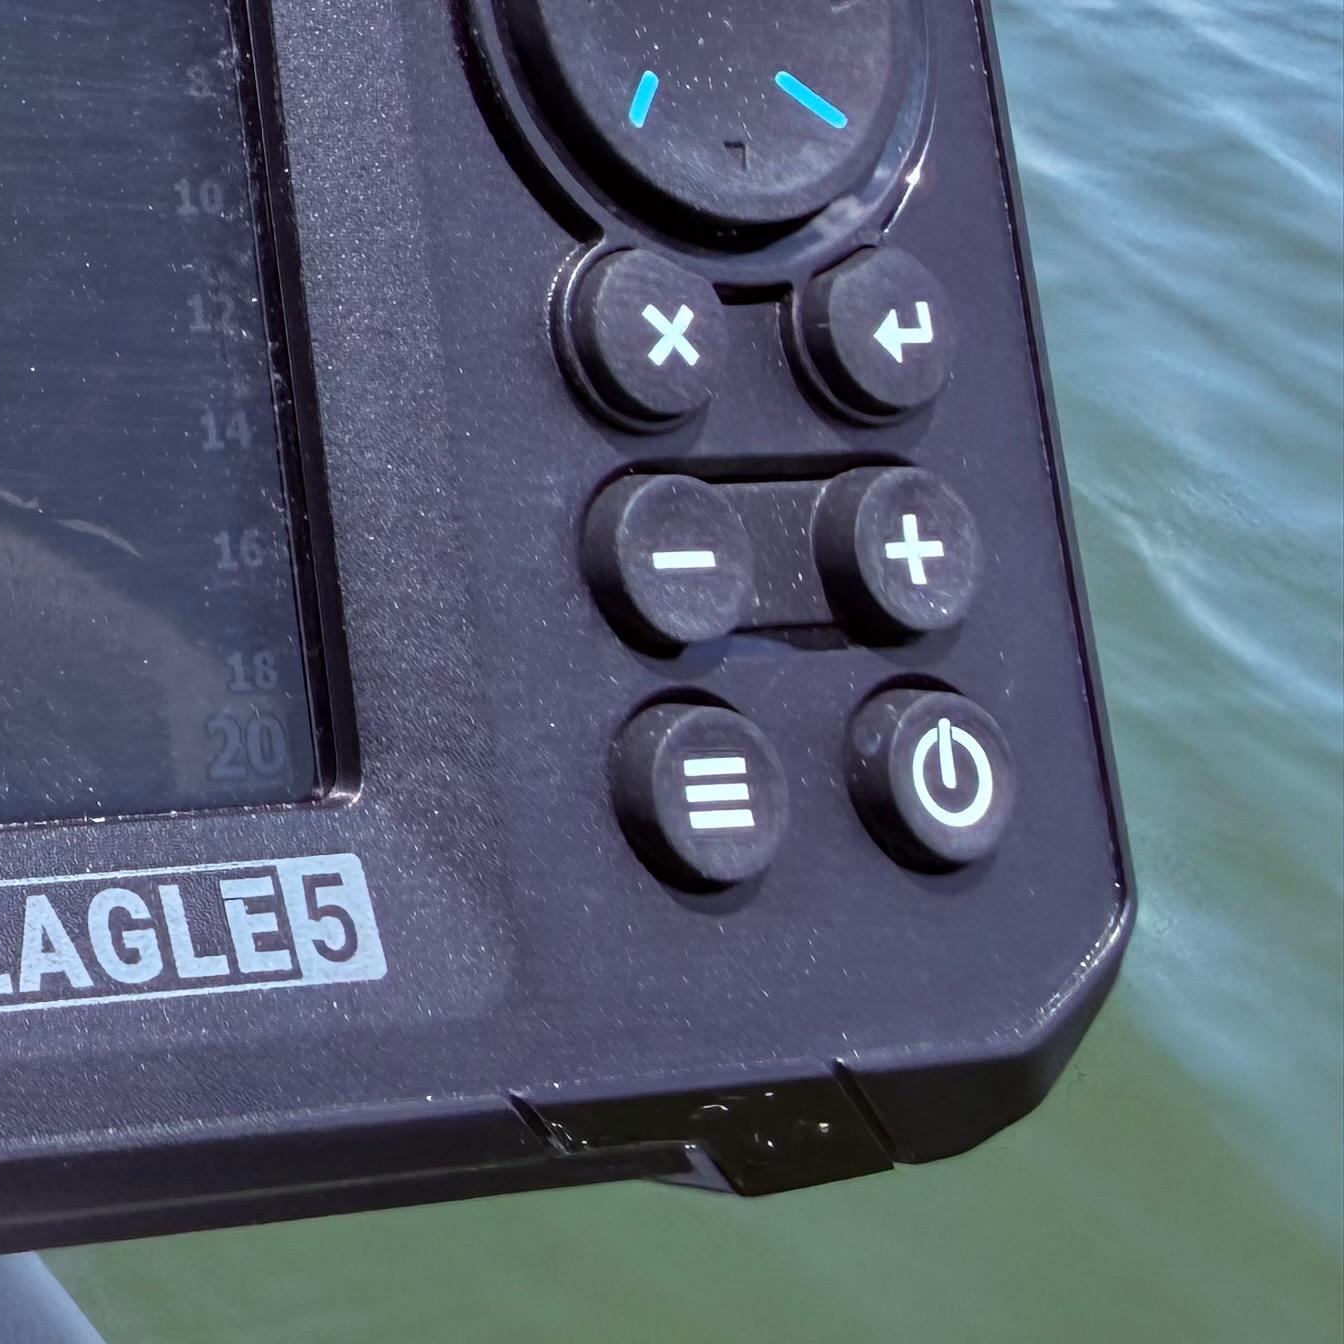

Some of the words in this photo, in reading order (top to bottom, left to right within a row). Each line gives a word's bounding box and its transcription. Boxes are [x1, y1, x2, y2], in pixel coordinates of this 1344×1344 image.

[173, 177, 224, 216] 10
[186, 293, 237, 337] 12
[200, 411, 254, 450] 14
[214, 529, 264, 570] 16
[226, 652, 279, 692] 18
[208, 714, 289, 781] 20
